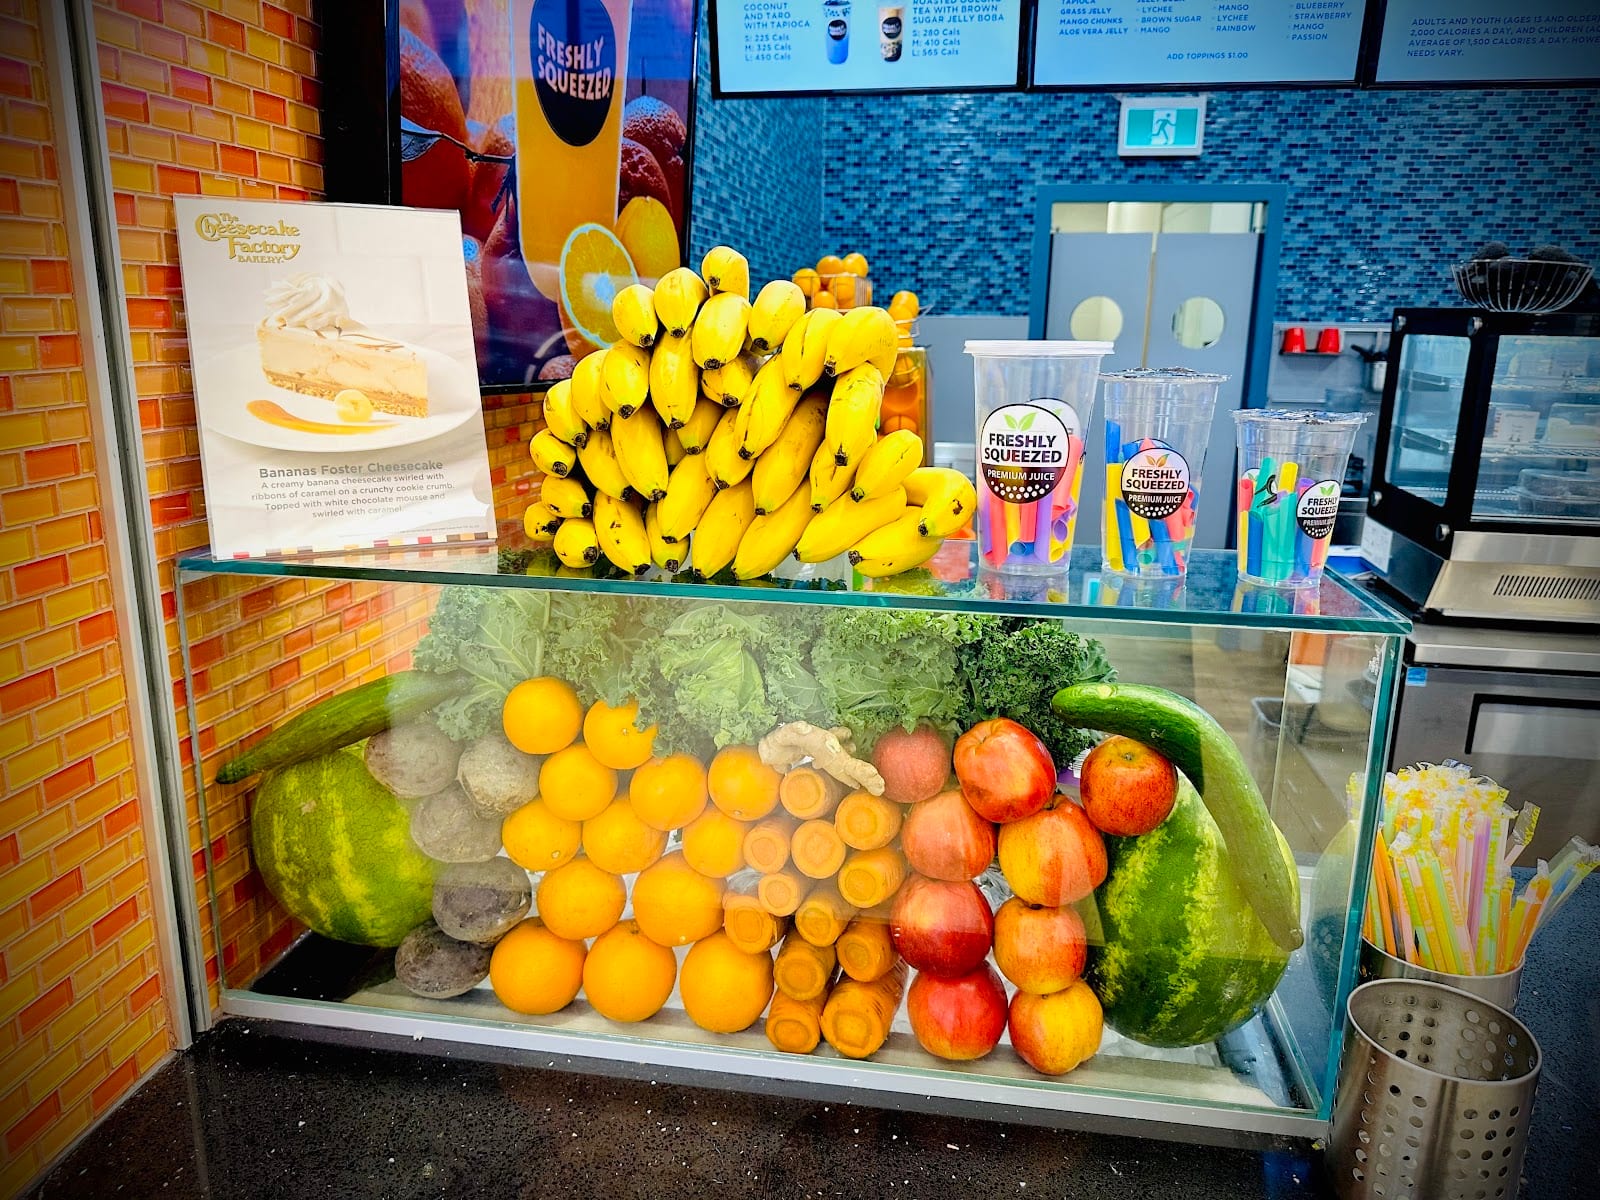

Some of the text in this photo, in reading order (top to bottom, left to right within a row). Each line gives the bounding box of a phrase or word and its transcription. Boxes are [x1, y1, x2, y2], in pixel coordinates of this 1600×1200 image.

[744, 3, 787, 11] COCONUT
[913, 16, 944, 24] SUGAR
[978, 14, 1004, 22] BOBA
[1503, 16, 1530, 24] (AGES
[1538, 26, 1583, 34] CHILDREN
[537, 22, 604, 70] FRESHLY
[941, 48, 958, 56] Cals
[194, 213, 300, 241] Cheesecake
[219, 234, 300, 260] Factory
[989, 433, 1056, 448] FRESHLY
[984, 447, 1062, 463] SQUEEZED
[260, 460, 444, 478] Bananas Foster Cheesecake
[987, 469, 1056, 480] PREMIUM JUICE
[1132, 468, 1182, 480] FRESHLY
[271, 480, 304, 488] creamy
[342, 476, 392, 485] cheesecake
[394, 474, 424, 482] swirled
[1126, 479, 1185, 490] SQUEEZED
[252, 492, 286, 500] ribbons
[301, 489, 336, 498] caramel
[360, 486, 394, 494] crunchy
[396, 484, 424, 492] cookie
[265, 502, 300, 511] Topped
[302, 500, 322, 508] with
[325, 499, 349, 507] white
[352, 496, 394, 504] chocolate
[1128, 494, 1182, 504] PREMIUM JUICE
[312, 510, 344, 518] swirled
[346, 507, 366, 516] with
